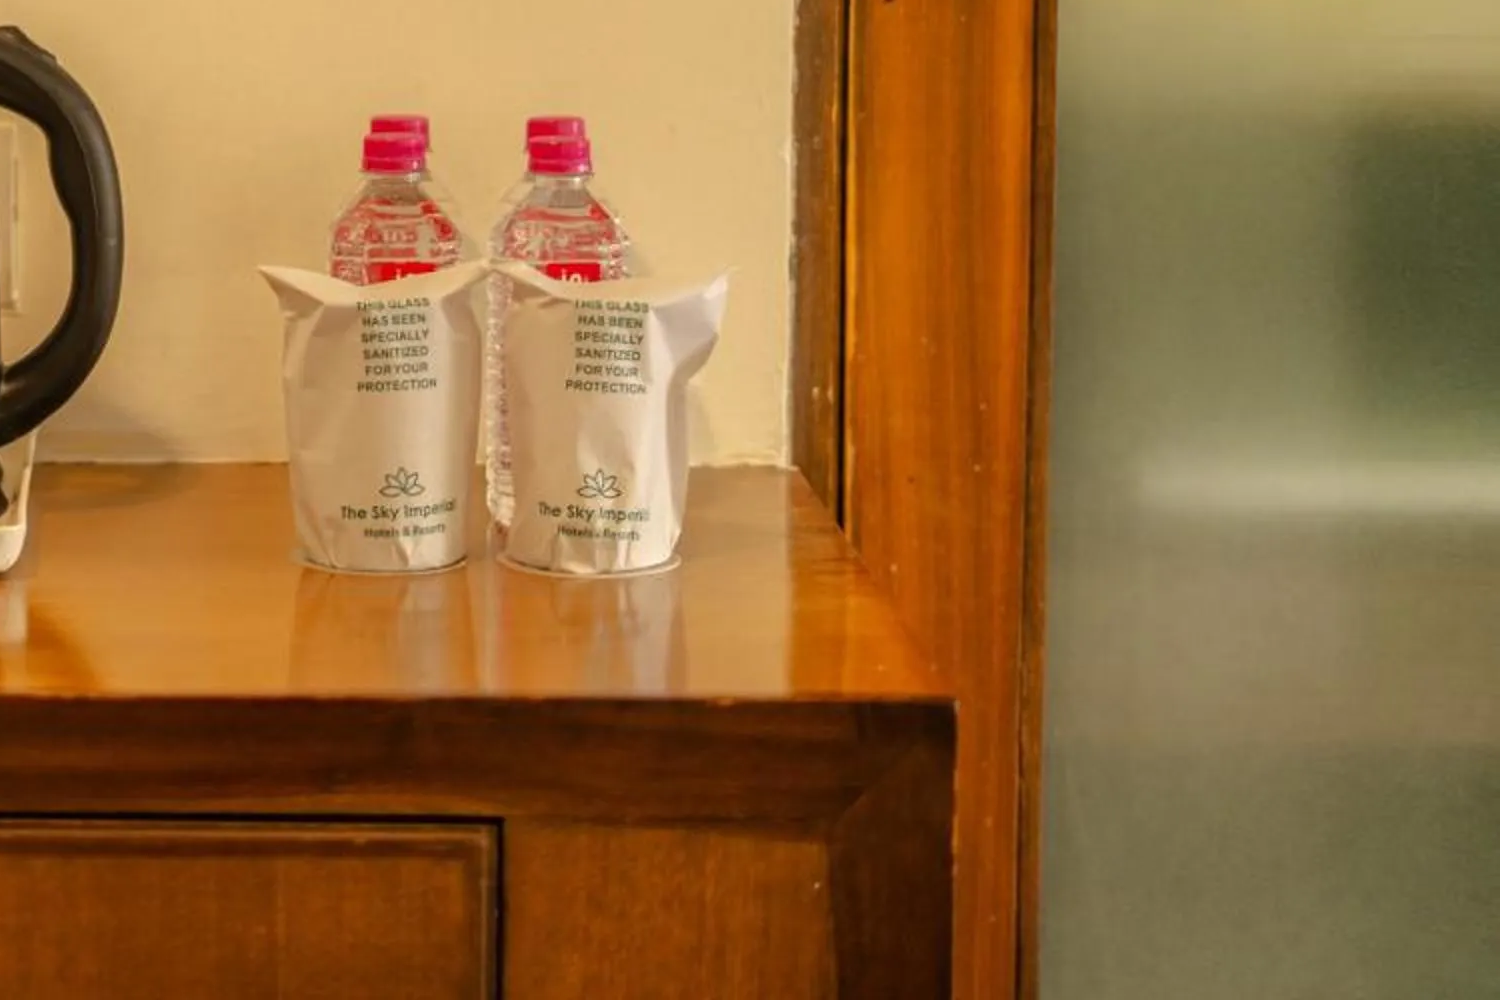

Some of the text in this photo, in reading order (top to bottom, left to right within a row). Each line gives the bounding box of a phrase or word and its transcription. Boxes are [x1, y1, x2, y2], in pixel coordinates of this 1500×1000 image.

[362, 313, 426, 327] HAS BEEN
[577, 315, 643, 329] HAS BEEN
[361, 329, 430, 344] SPECIALLY
[575, 331, 644, 346] SPECIALLY
[363, 345, 429, 360] SANITIZED
[575, 347, 641, 361] SANITIZED
[365, 362, 428, 377] FOR YOUR
[575, 363, 638, 377] FOR YOUR
[357, 379, 437, 393] PROTECTION
[565, 379, 647, 394] PROTECTION
[341, 505, 366, 519] The
[371, 505, 399, 521] Sky
[538, 502, 562, 517] The
[567, 505, 595, 521] Sky
